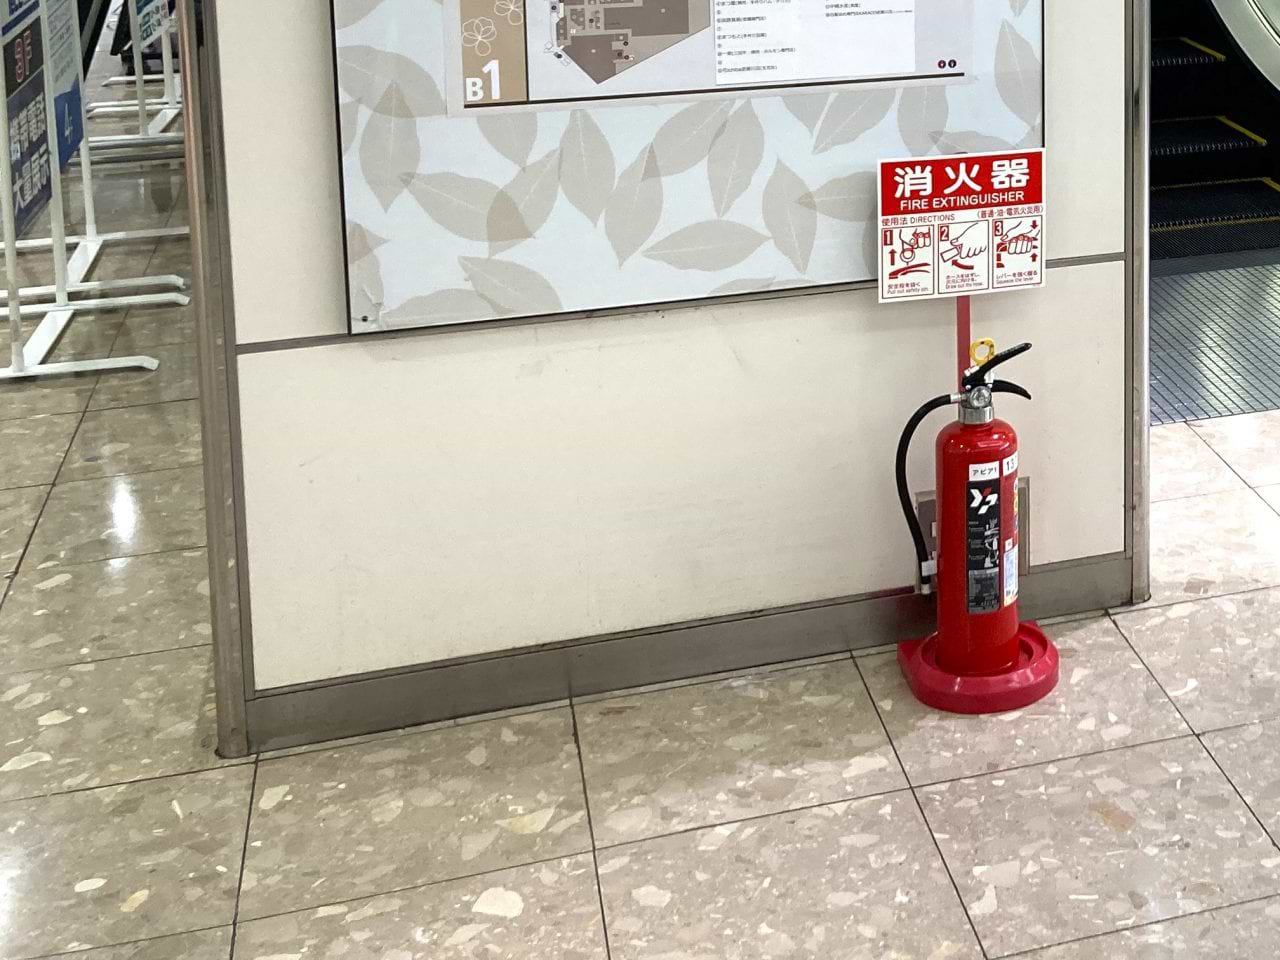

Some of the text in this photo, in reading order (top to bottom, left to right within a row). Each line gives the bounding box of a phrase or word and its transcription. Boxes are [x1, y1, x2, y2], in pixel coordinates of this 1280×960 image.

[465, 60, 502, 102] B1
[894, 158, 1030, 198] 消火器
[900, 191, 1025, 211] FIRE EXTINGUISHER
[881, 214, 955, 226] 使用法 DIRECTIONS
[995, 221, 1003, 236] 3
[940, 226, 949, 240] 2
